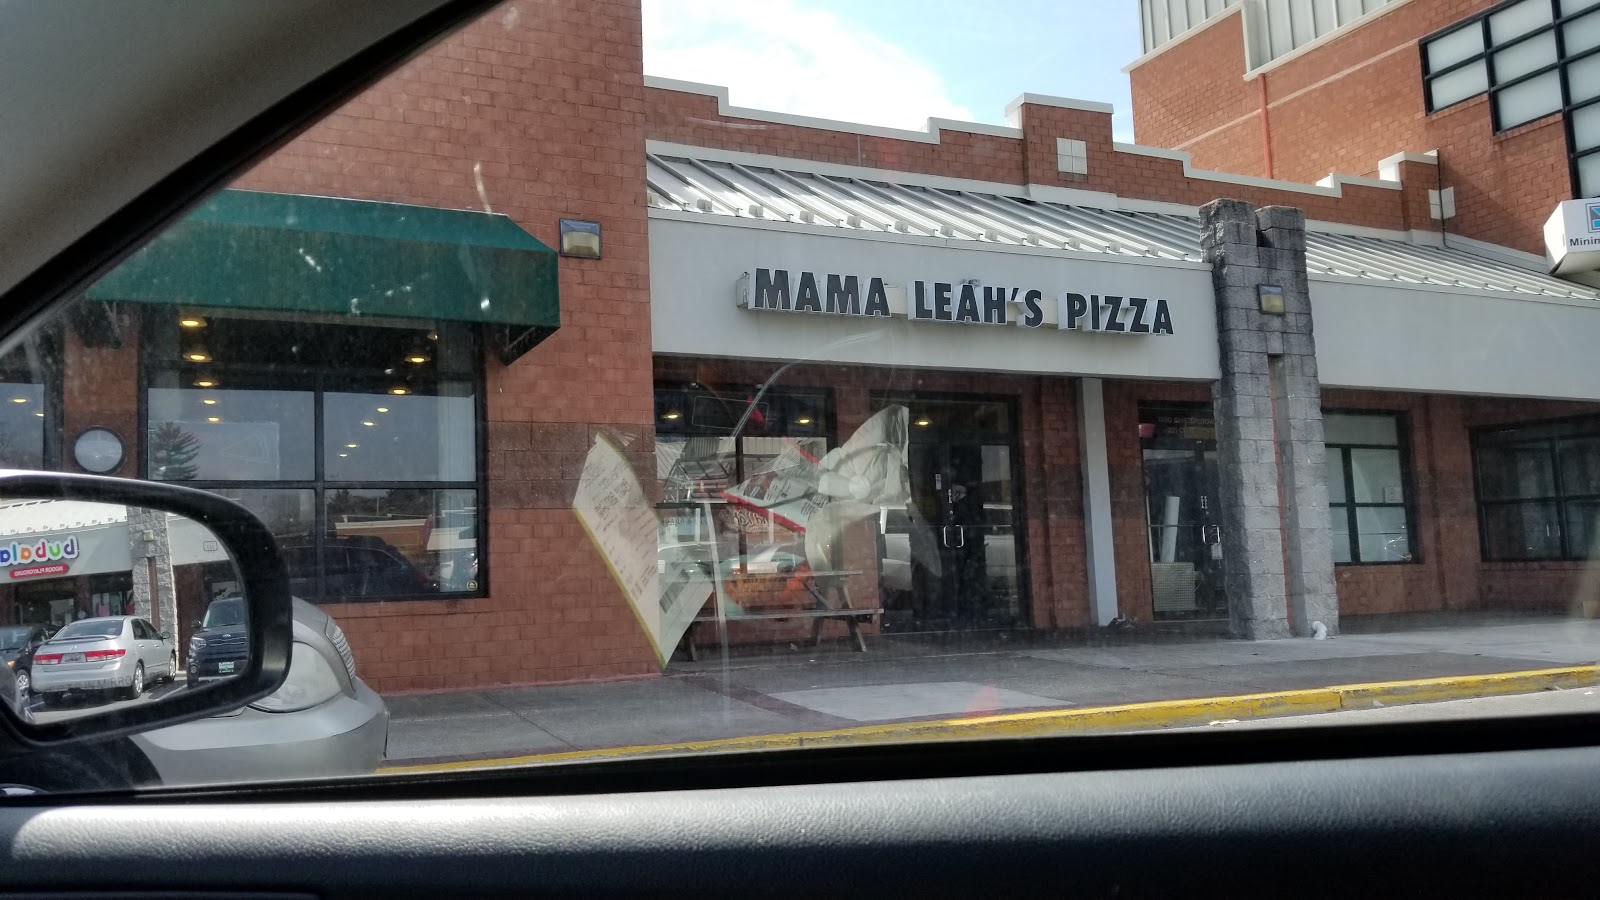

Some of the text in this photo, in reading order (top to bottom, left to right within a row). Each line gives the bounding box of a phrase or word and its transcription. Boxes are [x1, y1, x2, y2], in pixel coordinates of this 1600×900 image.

[754, 267, 1174, 335] MAMA LEAH'S PIZZA
[97, 675, 133, 689] MIRRO
